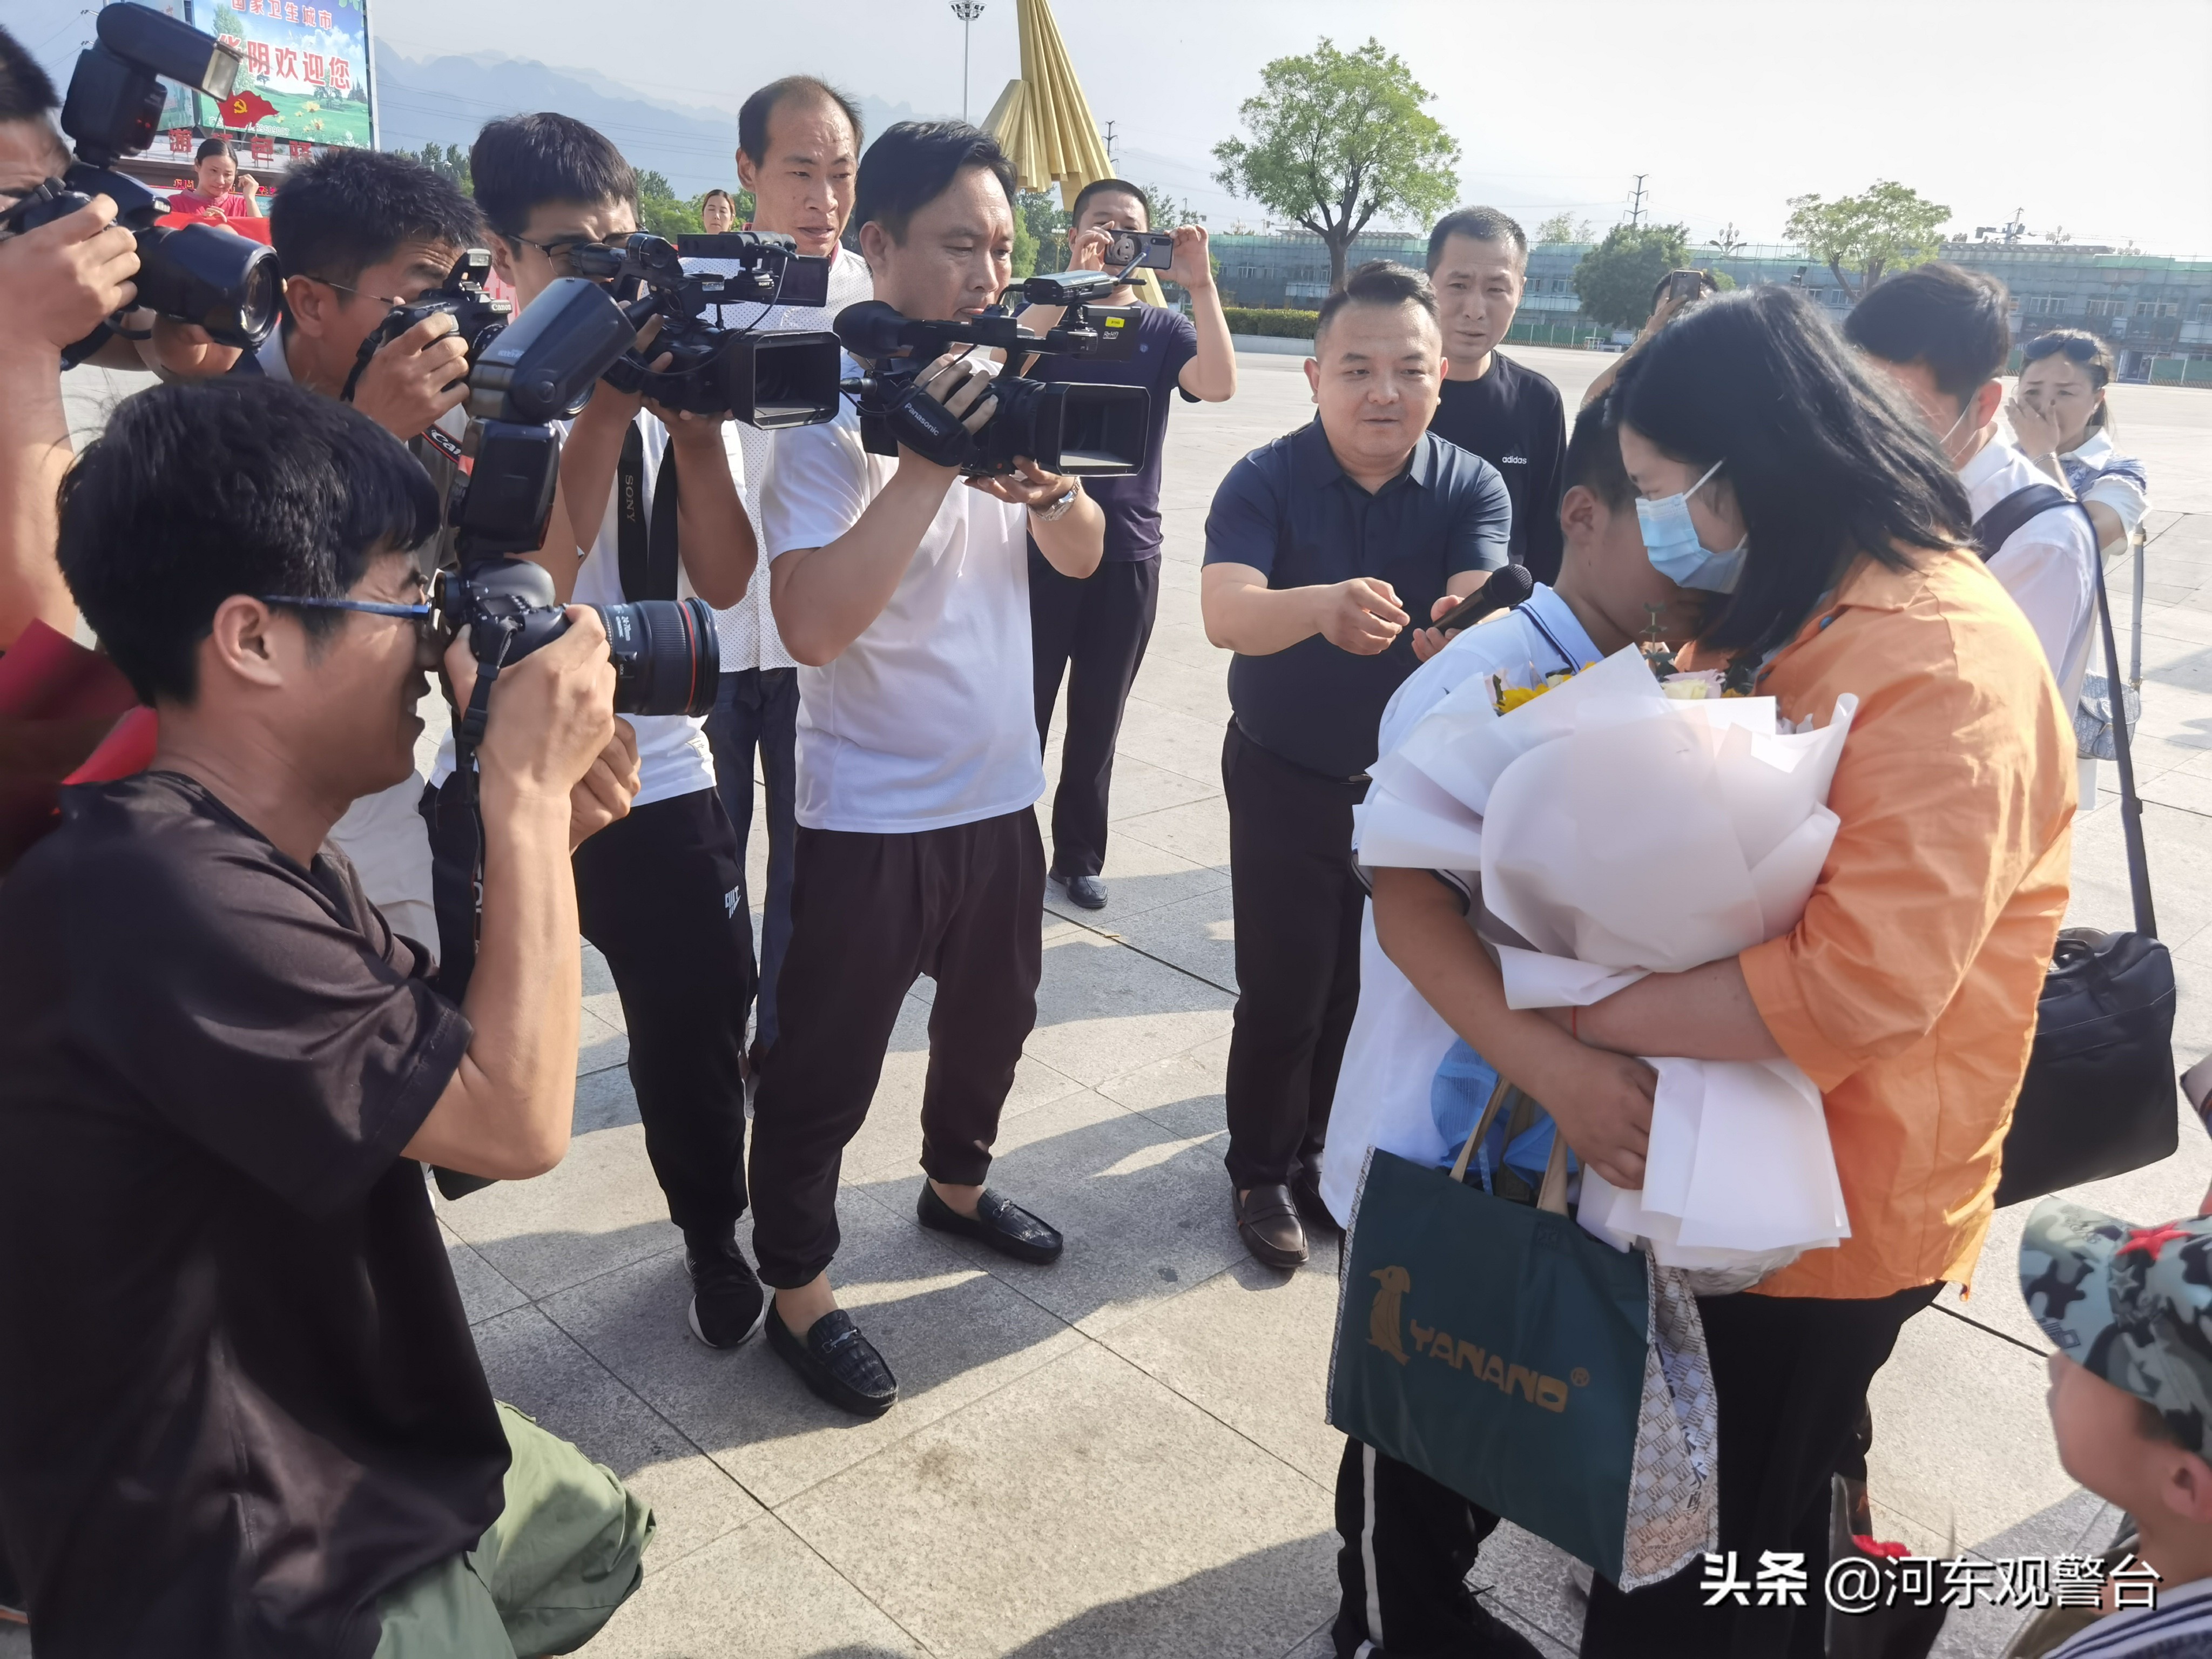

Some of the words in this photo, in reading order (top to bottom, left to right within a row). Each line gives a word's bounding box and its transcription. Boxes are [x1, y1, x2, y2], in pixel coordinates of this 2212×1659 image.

[232, 0, 332, 30] 国家卫生城市
[904, 402, 939, 436] Panasonic
[1502, 455, 1527, 464] adidas
[625, 475, 636, 523] SONY
[1410, 1318, 1569, 1413] YANANO
